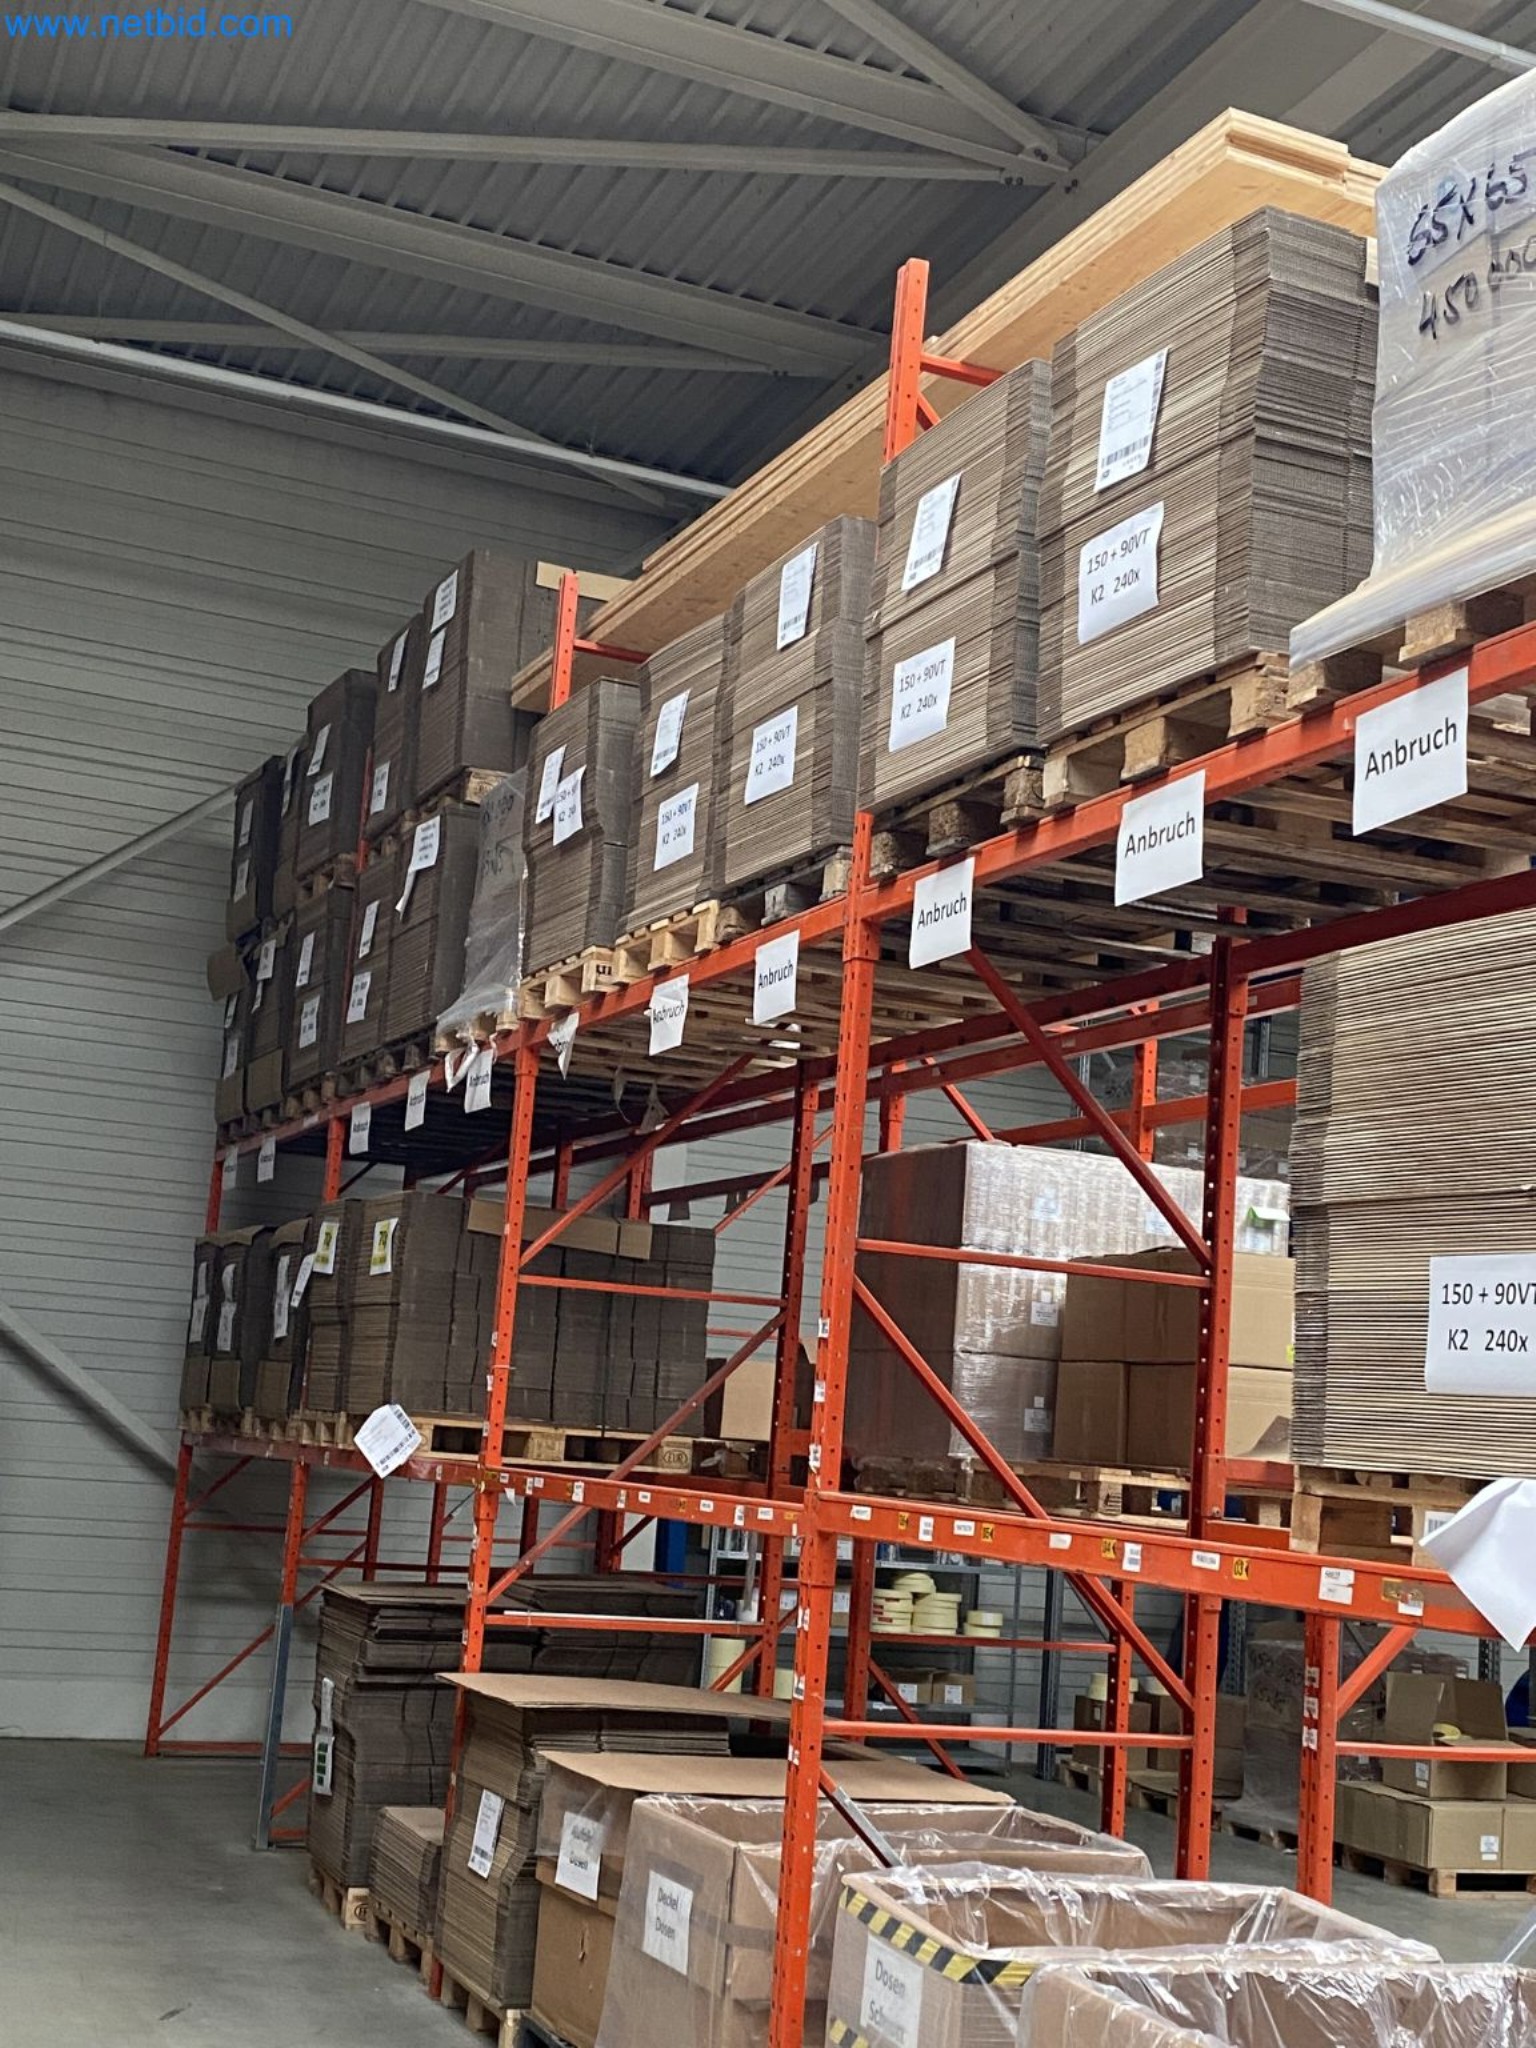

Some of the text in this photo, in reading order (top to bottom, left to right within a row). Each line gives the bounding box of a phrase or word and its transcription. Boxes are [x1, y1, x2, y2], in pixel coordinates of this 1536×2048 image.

[1087, 527, 1151, 575] 150 + 90VT
[1091, 568, 1140, 605] K2 240x
[899, 673, 915, 692] 150
[901, 703, 911, 719] K2
[1364, 717, 1457, 780] Anbruch
[1124, 811, 1196, 859] Anbruch
[917, 891, 967, 930] Anbruch
[758, 959, 794, 990] Anbruch
[1441, 1283, 1473, 1305] 150
[1478, 1286, 1488, 1303] +
[1448, 1329, 1529, 1352] K2 240x
[875, 1959, 905, 1999] Dosen
